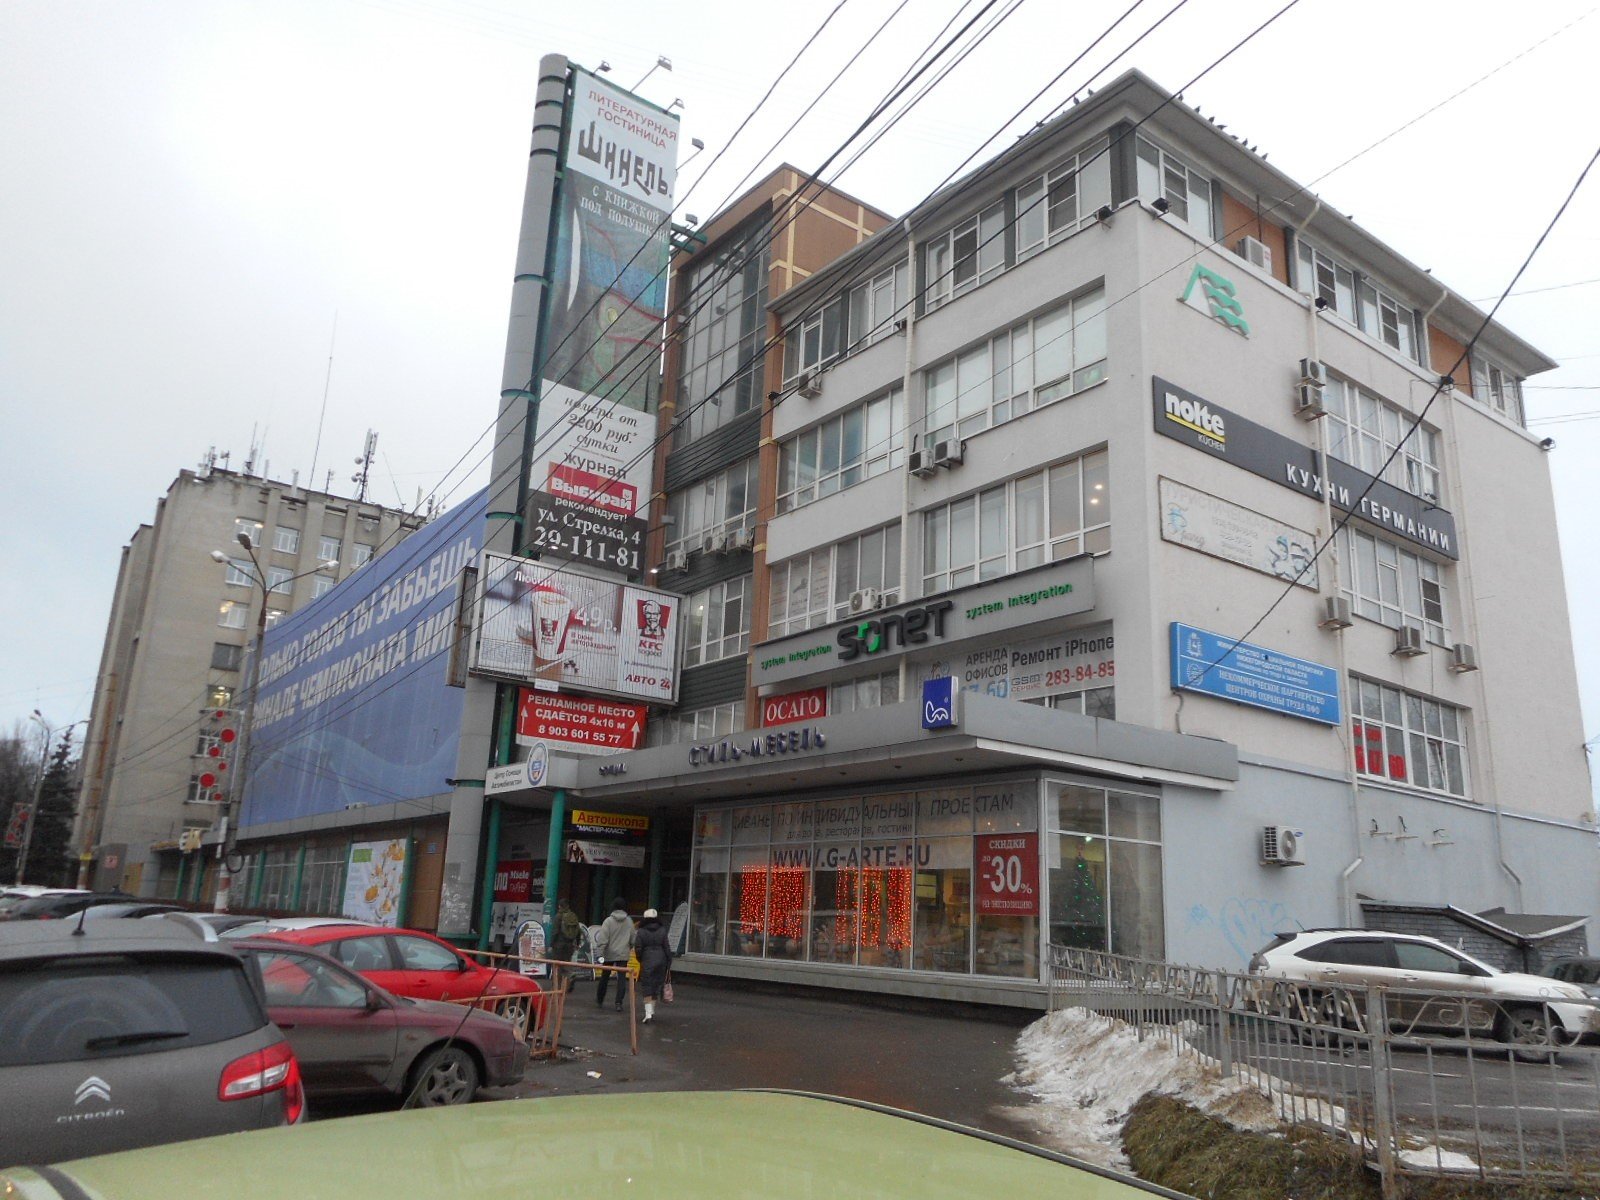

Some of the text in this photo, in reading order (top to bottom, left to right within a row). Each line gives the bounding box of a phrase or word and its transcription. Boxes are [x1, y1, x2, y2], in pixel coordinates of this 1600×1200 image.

[589, 90, 677, 141] ЛИТЕРАТУРНАЯ
[598, 108, 666, 149] ГОСТИНИЦА
[580, 196, 602, 217] ПОД
[605, 190, 660, 224] КНИЖКОЙ
[568, 413, 603, 433] 2200
[619, 415, 638, 428] от
[1165, 391, 1226, 437] nolte
[576, 434, 619, 454] сутки
[564, 452, 627, 480] журнал
[551, 476, 633, 511] Выбирай
[555, 497, 628, 523] рекомендует!
[1285, 463, 1450, 552] КУХНИ ГЕРМАНИИ
[537, 506, 641, 545] ул. Стрелка, 4
[533, 525, 640, 571] 29-111-81
[965, 583, 1073, 620] system integration
[300, 610, 349, 667] ГОЛОВ
[350, 592, 377, 640] ТЫ
[411, 605, 457, 664] МИ
[638, 639, 664, 651] KFC
[760, 644, 833, 670] system integration
[965, 647, 1008, 667] АРЕНДА
[1011, 634, 1115, 668] Ремонт iPhone
[624, 673, 657, 686] АВТО
[965, 663, 1008, 682] ОФИСОВ
[1045, 659, 1115, 688] 283-84-85
[527, 694, 636, 719] РЕКЛАМНОЕ МЕСТО
[766, 695, 821, 722] ОСАГО
[538, 724, 621, 744] 8 903 601 55 77
[577, 811, 646, 828] Автошкола
[989, 839, 1026, 850] СКИДКИ
